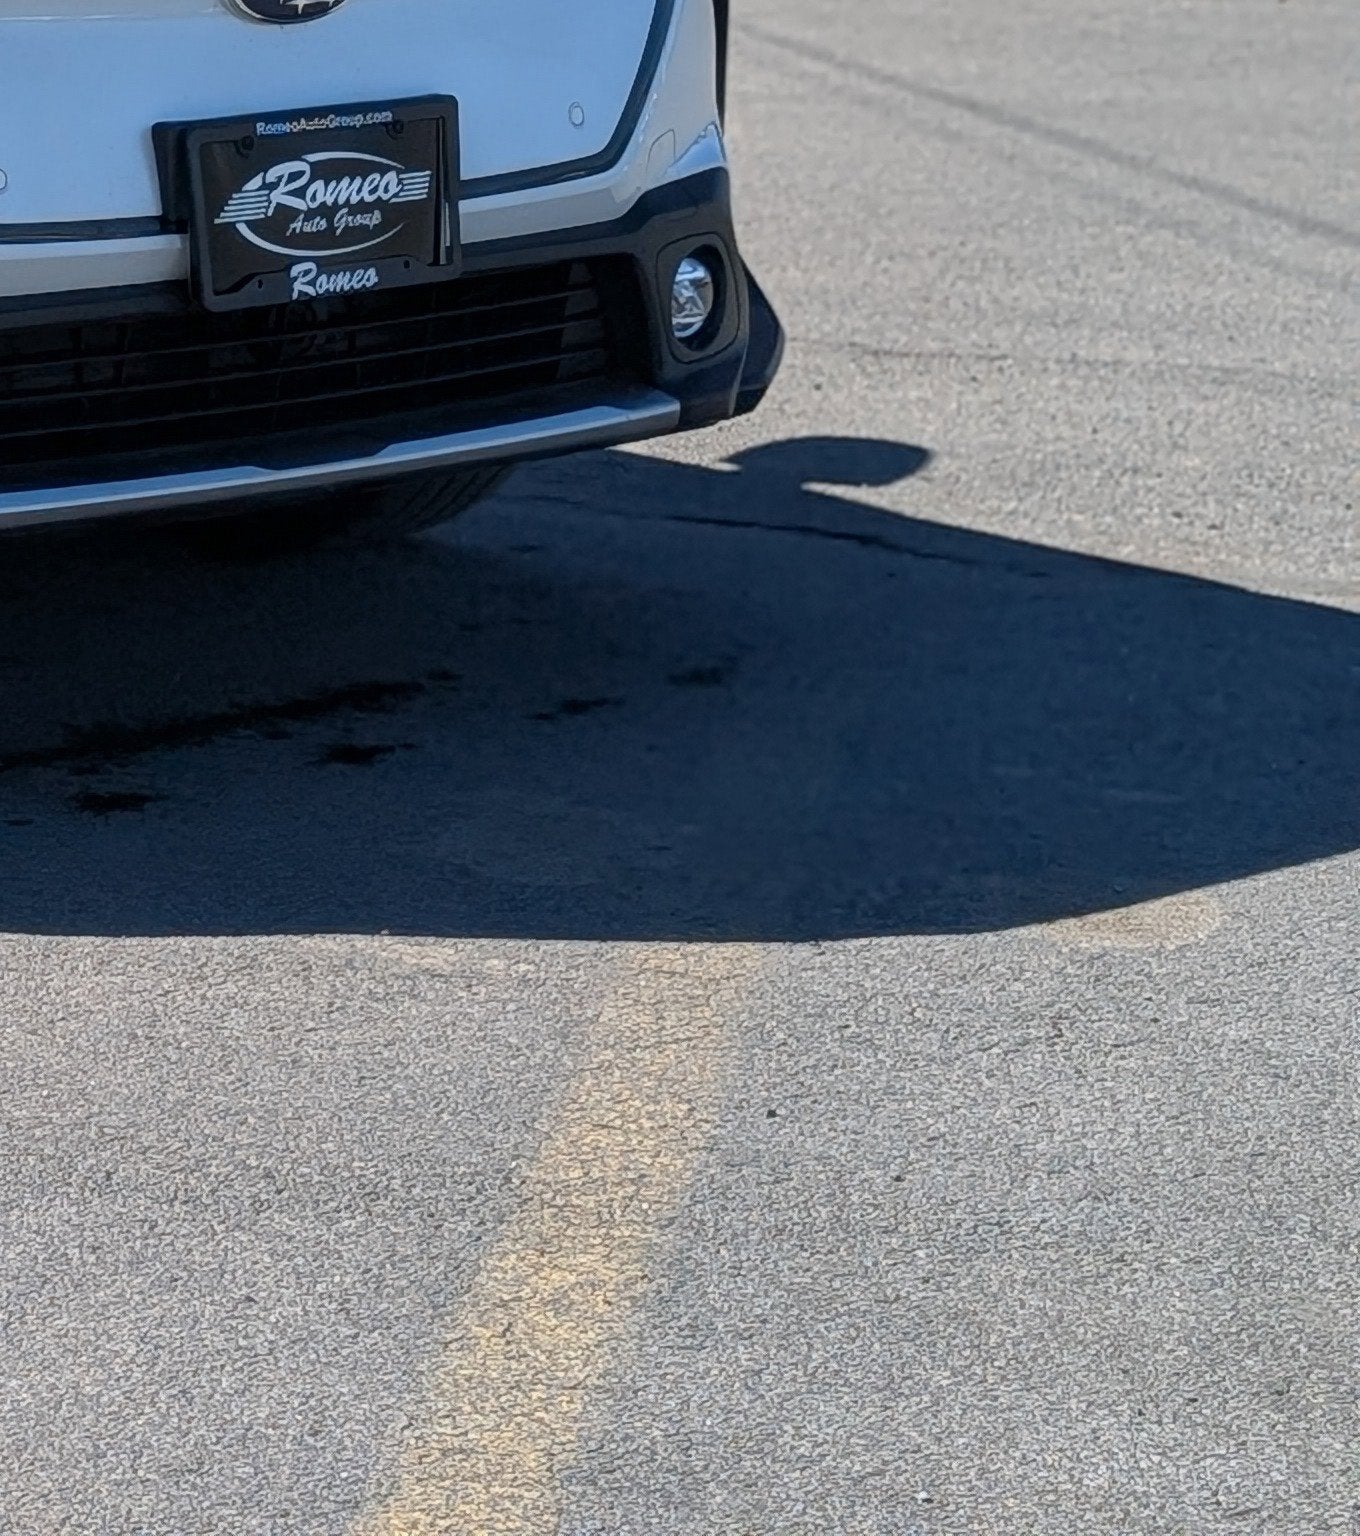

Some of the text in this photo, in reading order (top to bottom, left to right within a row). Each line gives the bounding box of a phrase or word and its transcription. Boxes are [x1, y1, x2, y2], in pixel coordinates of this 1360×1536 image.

[255, 110, 394, 136] RomeoAutoGroup.com
[264, 160, 403, 217] Romeo
[285, 208, 383, 237] Auto Group
[289, 261, 379, 301] Romeo
